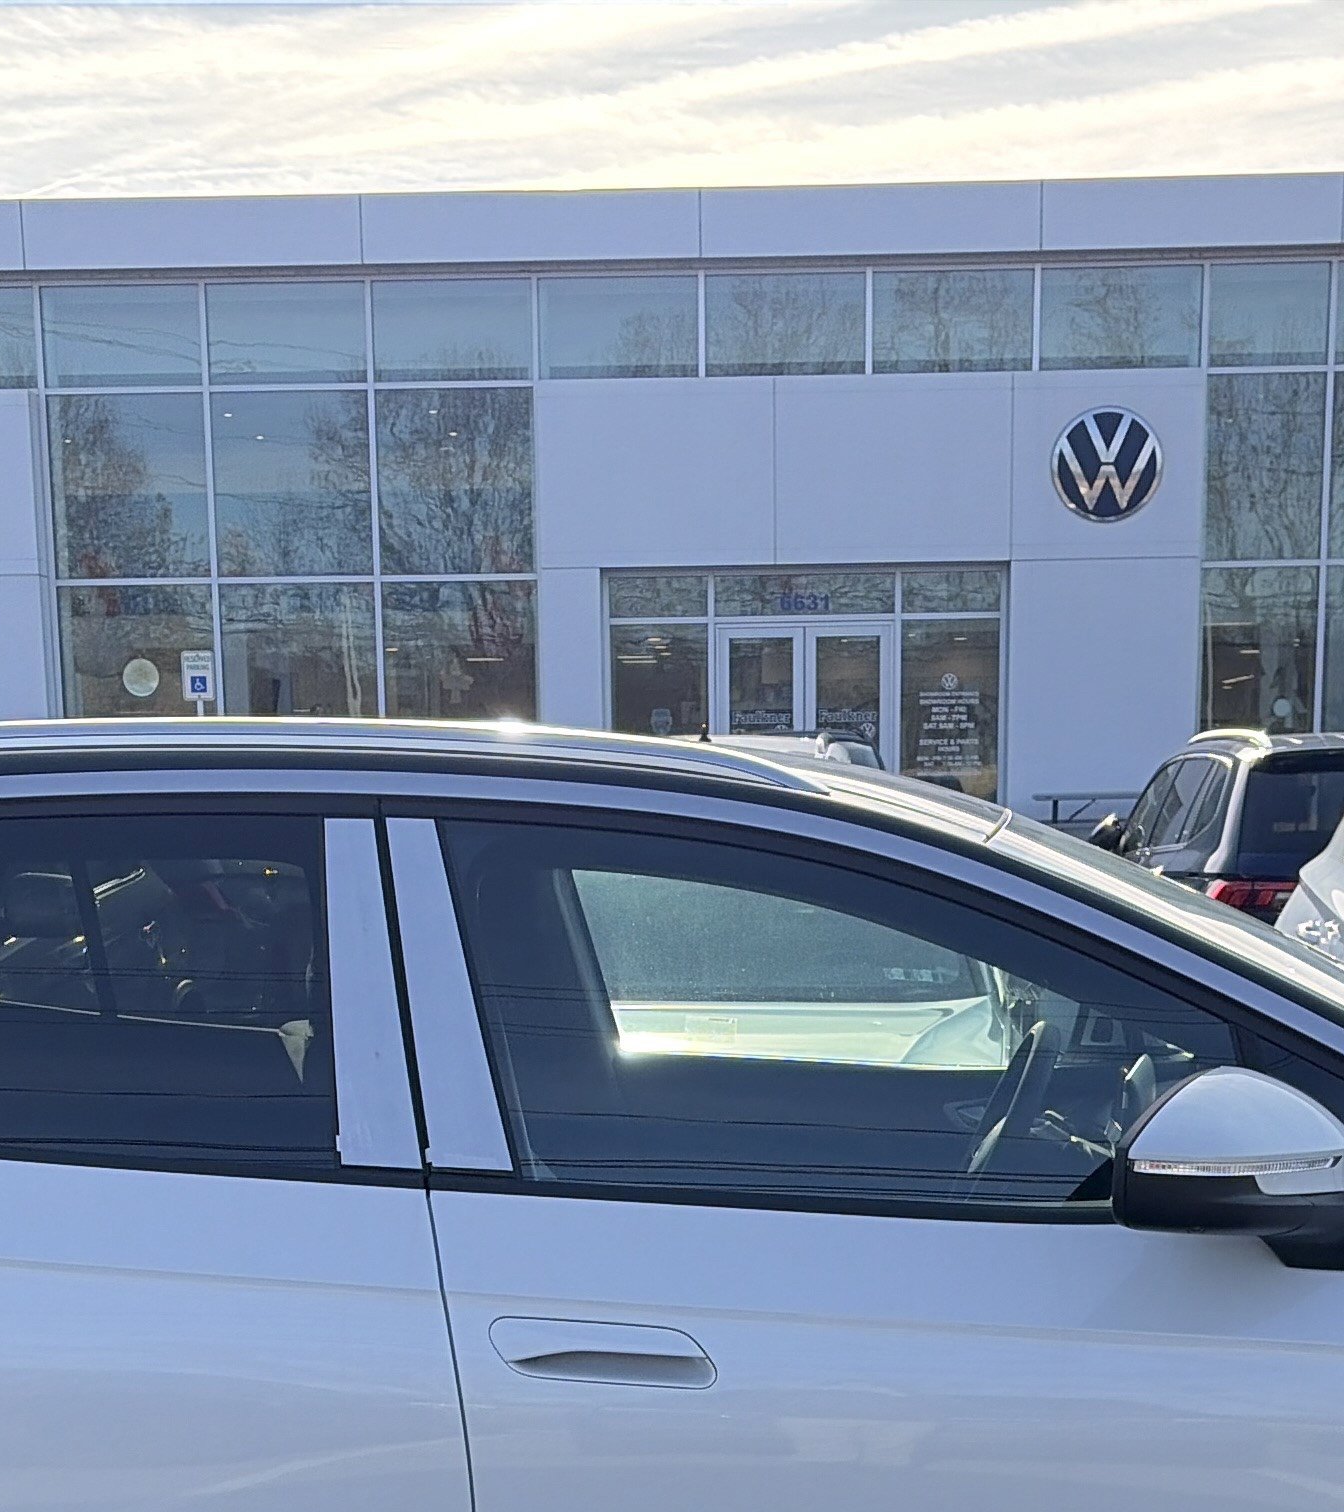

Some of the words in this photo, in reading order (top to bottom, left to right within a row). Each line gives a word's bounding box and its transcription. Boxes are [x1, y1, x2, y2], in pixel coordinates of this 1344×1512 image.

[1051, 406, 1163, 522] VW
[779, 591, 830, 611] 6631
[731, 710, 791, 725] Faulkner
[818, 708, 877, 723] Faulkner
